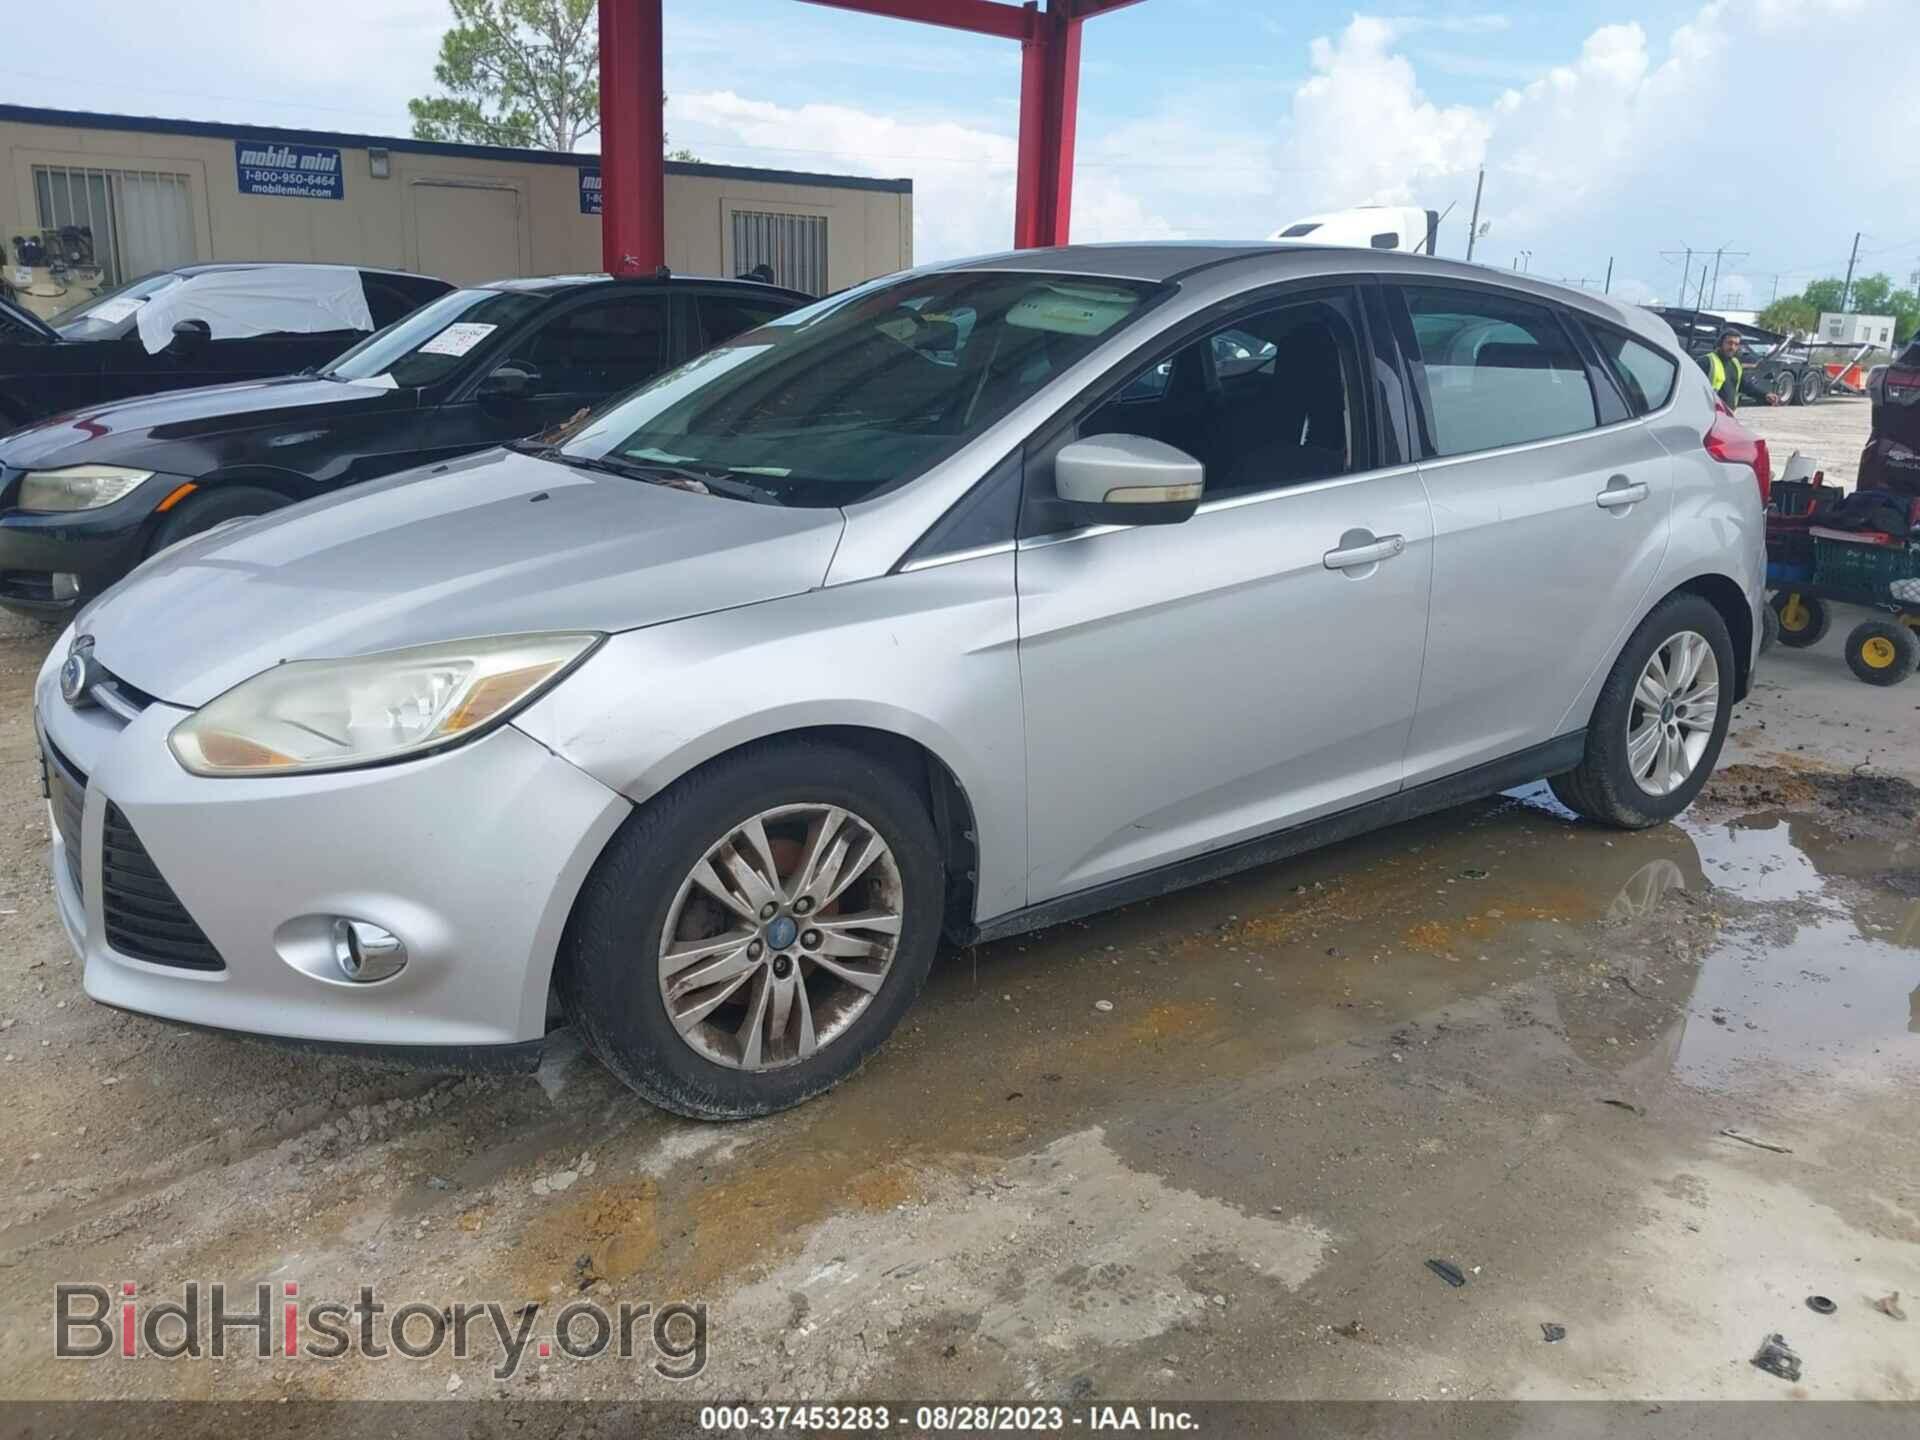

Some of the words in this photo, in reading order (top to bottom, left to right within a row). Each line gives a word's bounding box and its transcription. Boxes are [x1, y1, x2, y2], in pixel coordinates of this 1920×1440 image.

[240, 145, 297, 169] mobile
[300, 152, 337, 172] mini
[245, 170, 335, 186] 1-800-950-6464
[251, 183, 332, 197] mobilemini.com
